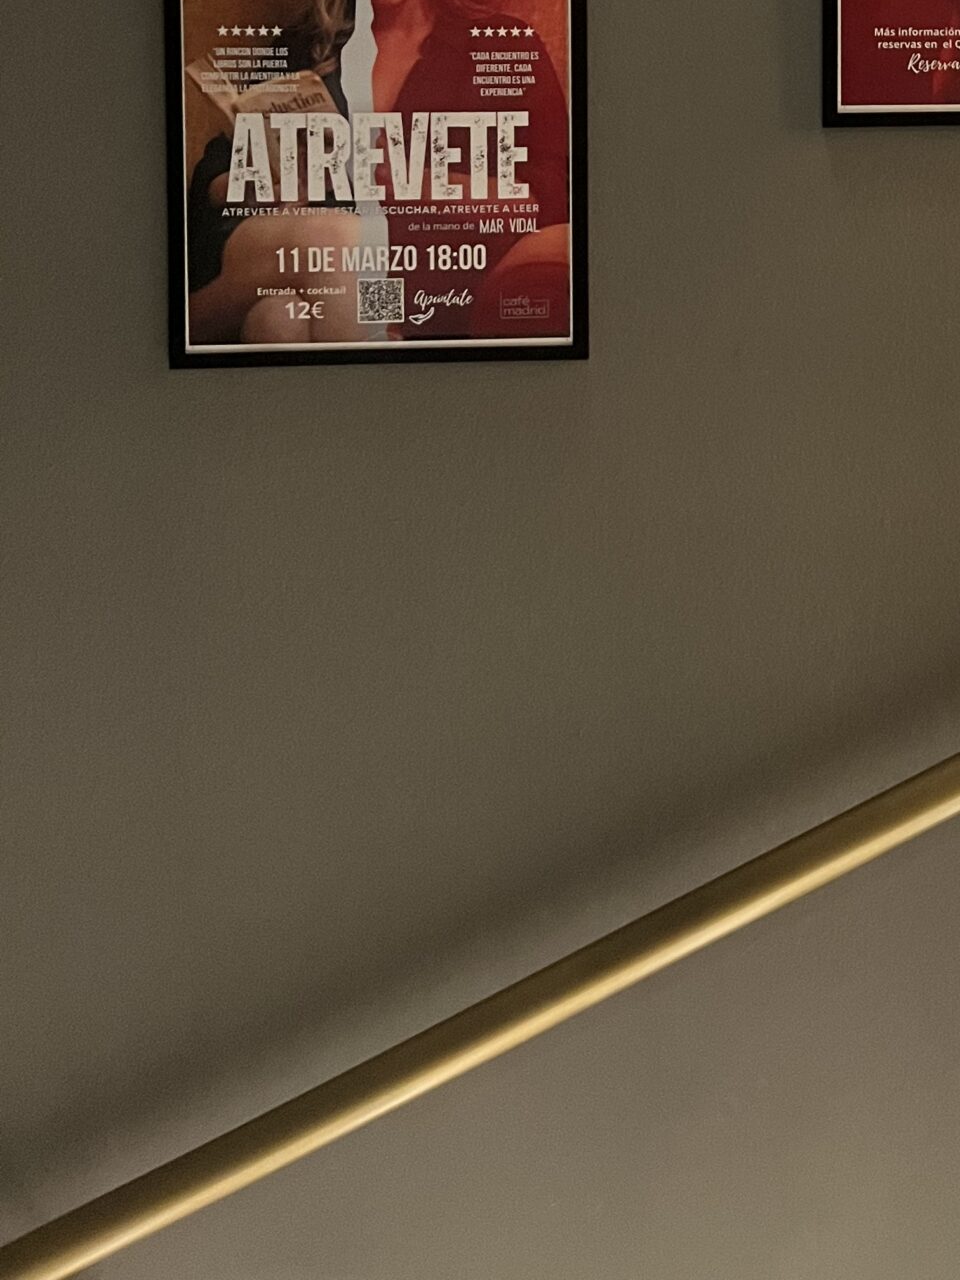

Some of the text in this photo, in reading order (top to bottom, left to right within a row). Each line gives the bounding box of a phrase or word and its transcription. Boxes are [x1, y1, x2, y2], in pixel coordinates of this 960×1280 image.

[874, 27, 896, 37] Más
[898, 27, 960, 37] información
[877, 40, 922, 49] reservas
[924, 40, 938, 49] en
[942, 39, 952, 49] el
[491, 51, 529, 60] ENCUENTRO
[530, 51, 539, 60] ES
[514, 64, 532, 72] CADA
[907, 52, 960, 74] Reserva
[473, 76, 535, 84] ENCUENTRO ES UNA
[226, 111, 529, 203] ATREVETE
[222, 207, 279, 217] ATREVETE
[282, 207, 290, 216] A
[443, 204, 499, 214] ATREVETE
[502, 204, 510, 213] A
[513, 204, 539, 213] LEER
[408, 217, 541, 234] de la mano de MAR VIDAL
[276, 244, 487, 273] 11 DE MARZO 18:00
[257, 287, 296, 296] Entrada
[306, 286, 347, 295] cocktail
[503, 295, 530, 306] café
[285, 301, 325, 320] 12€
[503, 304, 547, 316] madrid
